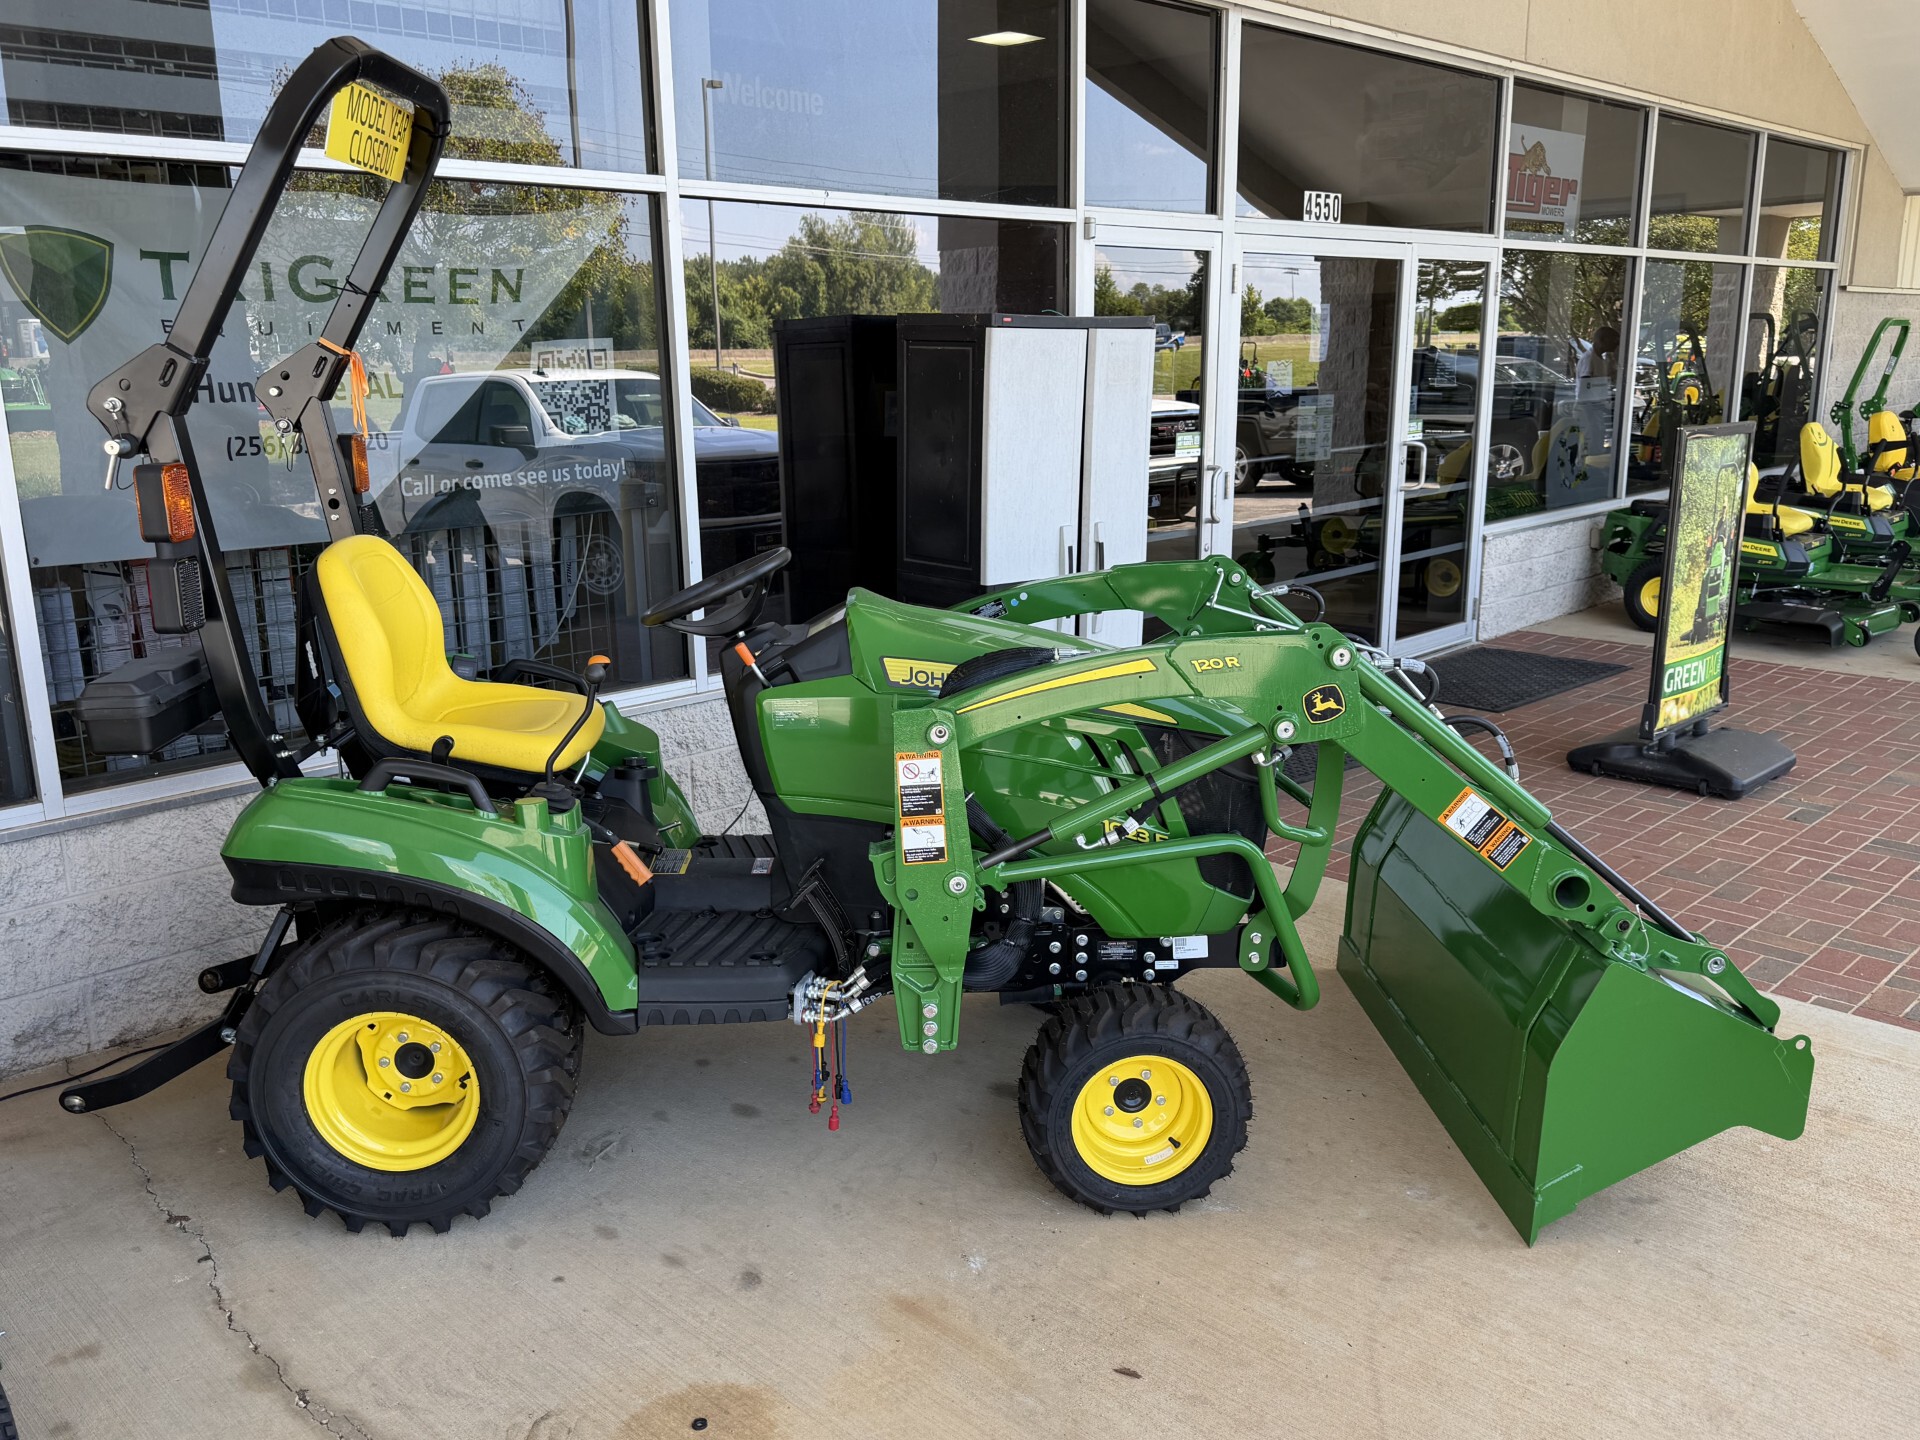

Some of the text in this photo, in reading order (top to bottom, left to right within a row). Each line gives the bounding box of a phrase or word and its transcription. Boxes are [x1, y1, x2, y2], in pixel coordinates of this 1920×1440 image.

[712, 69, 824, 116] Welcome
[346, 86, 410, 145] MODEL YEAR
[349, 129, 399, 177] CLOSEOUT
[1305, 193, 1340, 222] 4550
[1541, 206, 1565, 217] MOWERS
[139, 248, 525, 305] TIGEEN
[161, 318, 526, 337] EUIMENT
[226, 435, 283, 462] (256)
[400, 457, 627, 498] Call or come see us today!
[1750, 544, 1772, 553] DEERE
[901, 666, 950, 686] JOH
[905, 751, 940, 760] WARNING
[1447, 791, 1469, 814] WARNING
[908, 817, 943, 826] WARNING
[1490, 825, 1512, 848] WARNING
